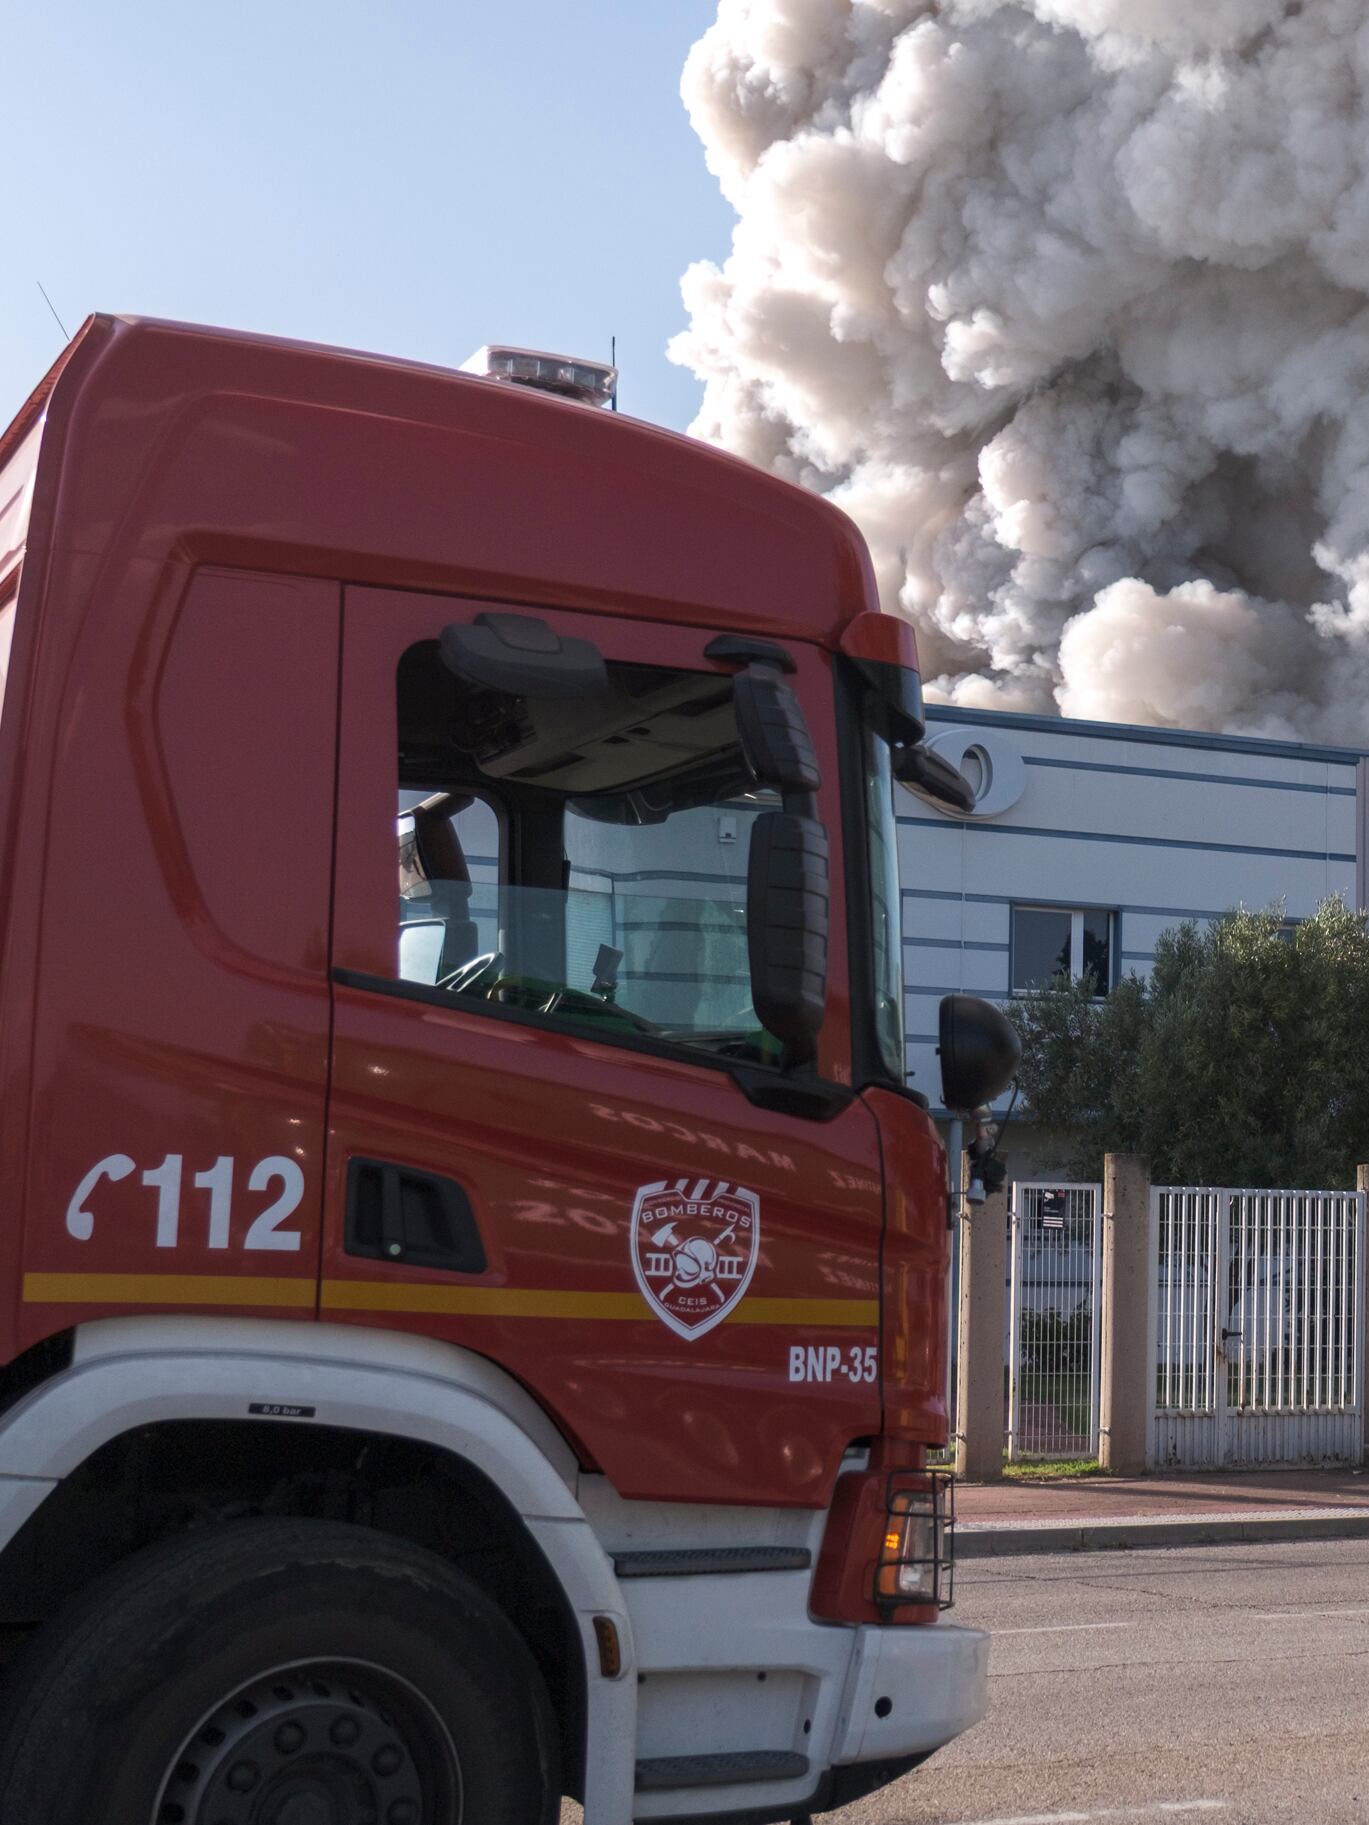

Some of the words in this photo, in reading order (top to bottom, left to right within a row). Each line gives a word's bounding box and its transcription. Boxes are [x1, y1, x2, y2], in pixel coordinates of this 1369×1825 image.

[143, 1154, 304, 1250] 112
[642, 1204, 751, 1227] BOMBEROS
[664, 1302, 720, 1312] GUADALAJARA
[678, 1296, 707, 1305] CEIS
[789, 1346, 878, 1382] BNP-35
[283, 1406, 302, 1415] bar
